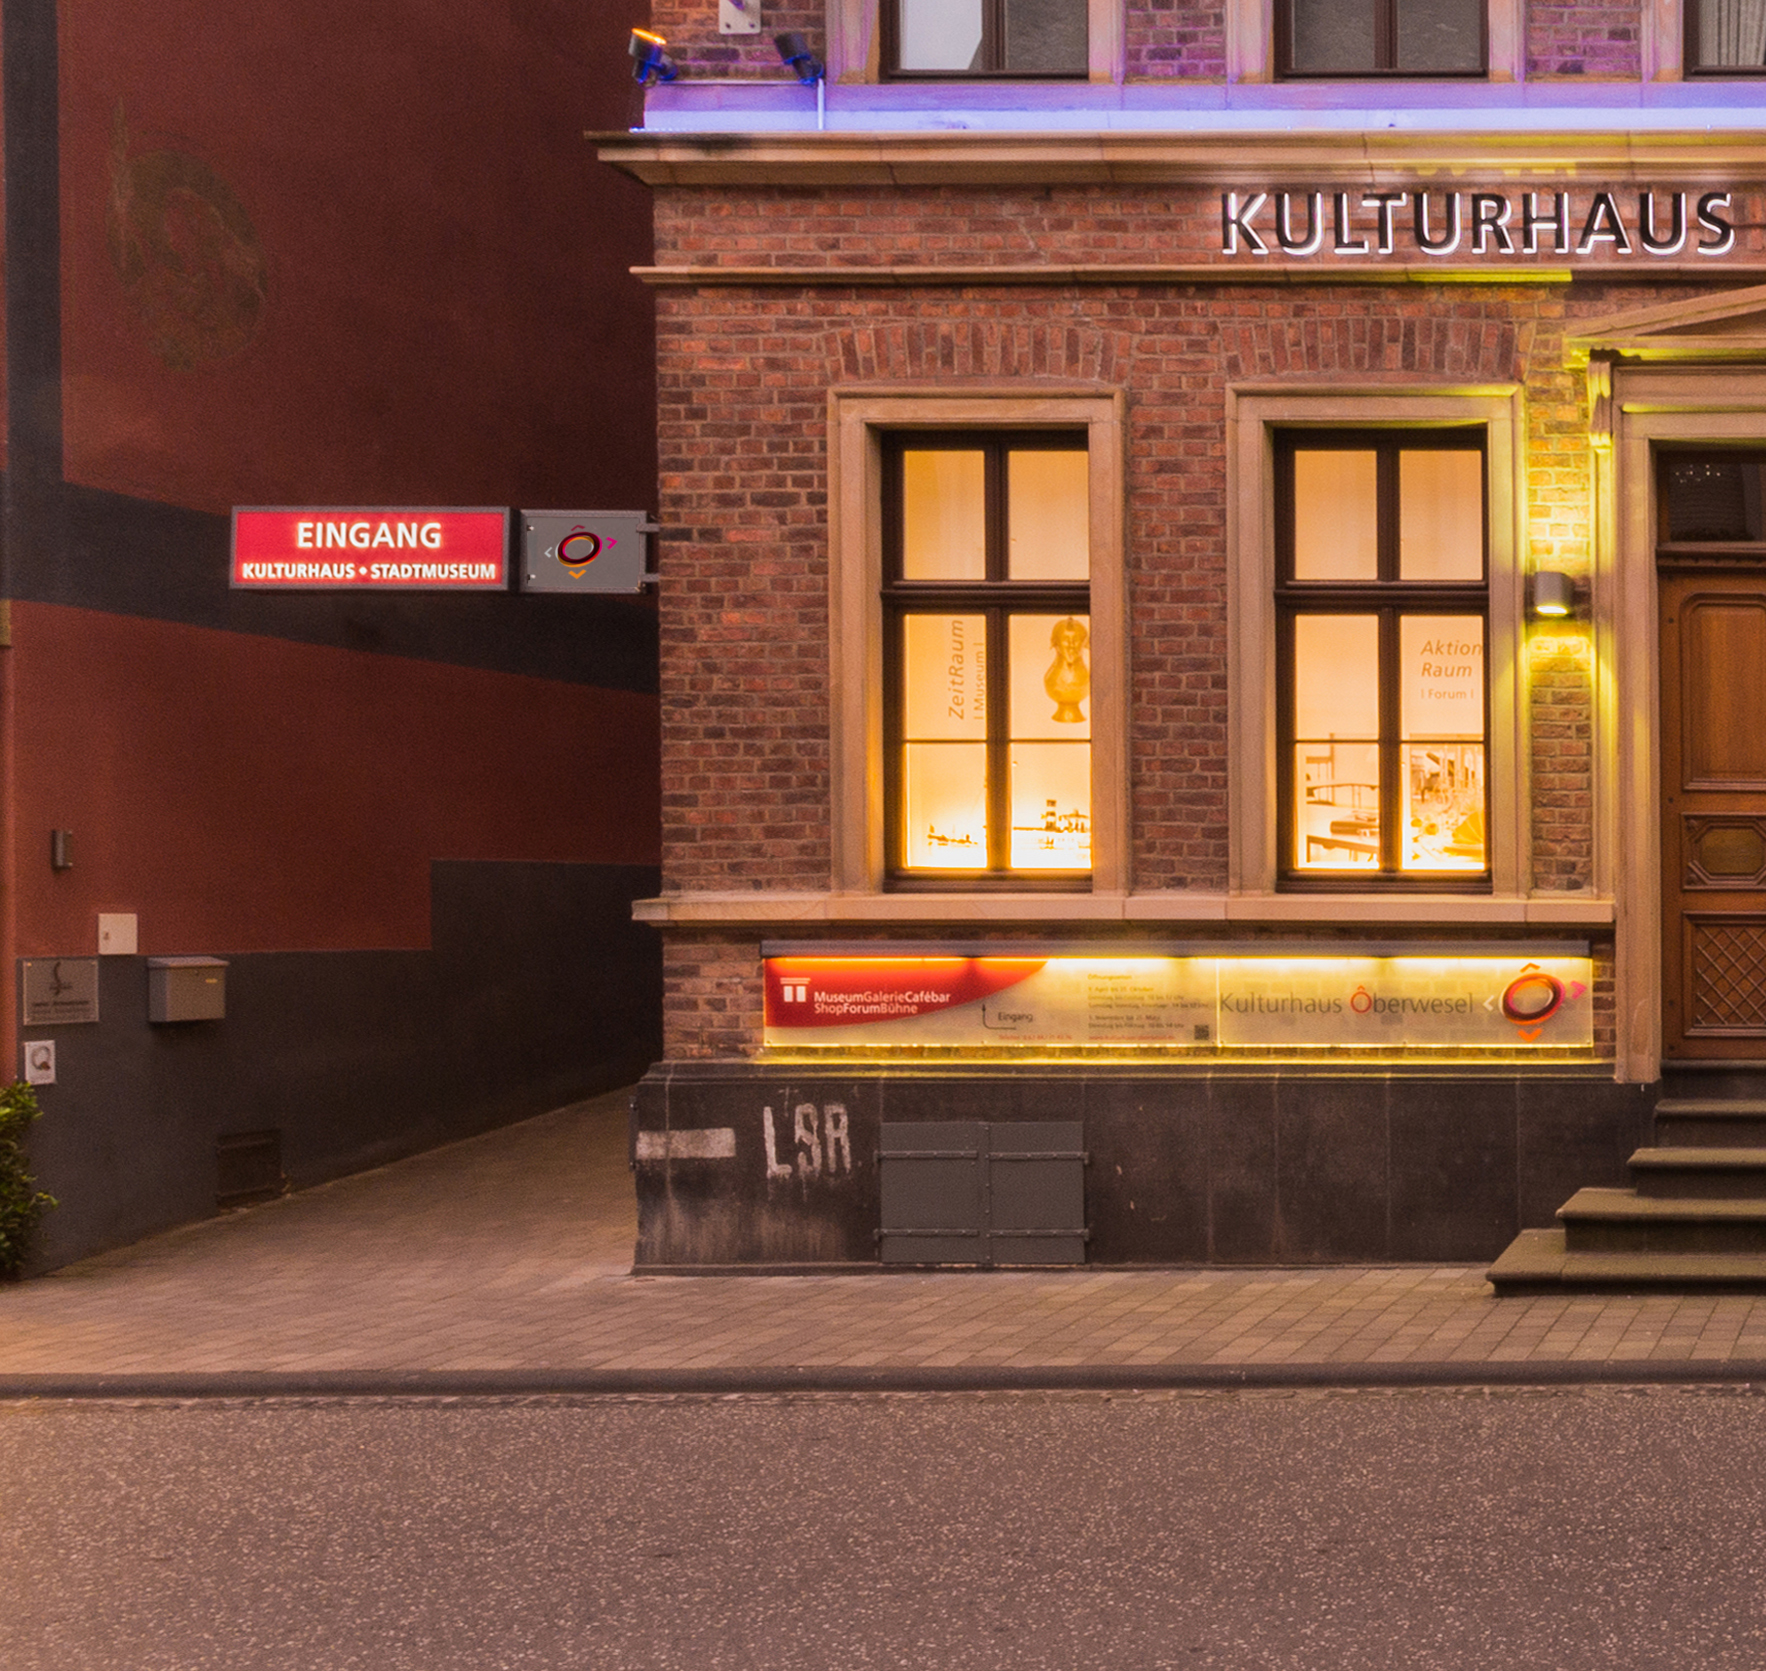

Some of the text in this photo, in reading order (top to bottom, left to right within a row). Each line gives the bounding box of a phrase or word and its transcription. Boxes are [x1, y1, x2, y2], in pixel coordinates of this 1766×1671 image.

[1221, 191, 1735, 256] KULTURHAUS
[297, 522, 442, 549] EINGANG
[242, 563, 496, 579] KULTURHAUS STADTMUSEUM
[1420, 639, 1483, 656] Aktion
[948, 619, 965, 720] ZeitRaum
[1421, 662, 1473, 678] Raum
[974, 650, 985, 711] Museum
[1428, 688, 1468, 699] Forum
[814, 990, 950, 1004] MuseumGalerieCafébar
[1219, 991, 1342, 1014] Kulturhaus
[814, 1002, 919, 1016] ShopForumBühne
[997, 1011, 1034, 1023] Eingang
